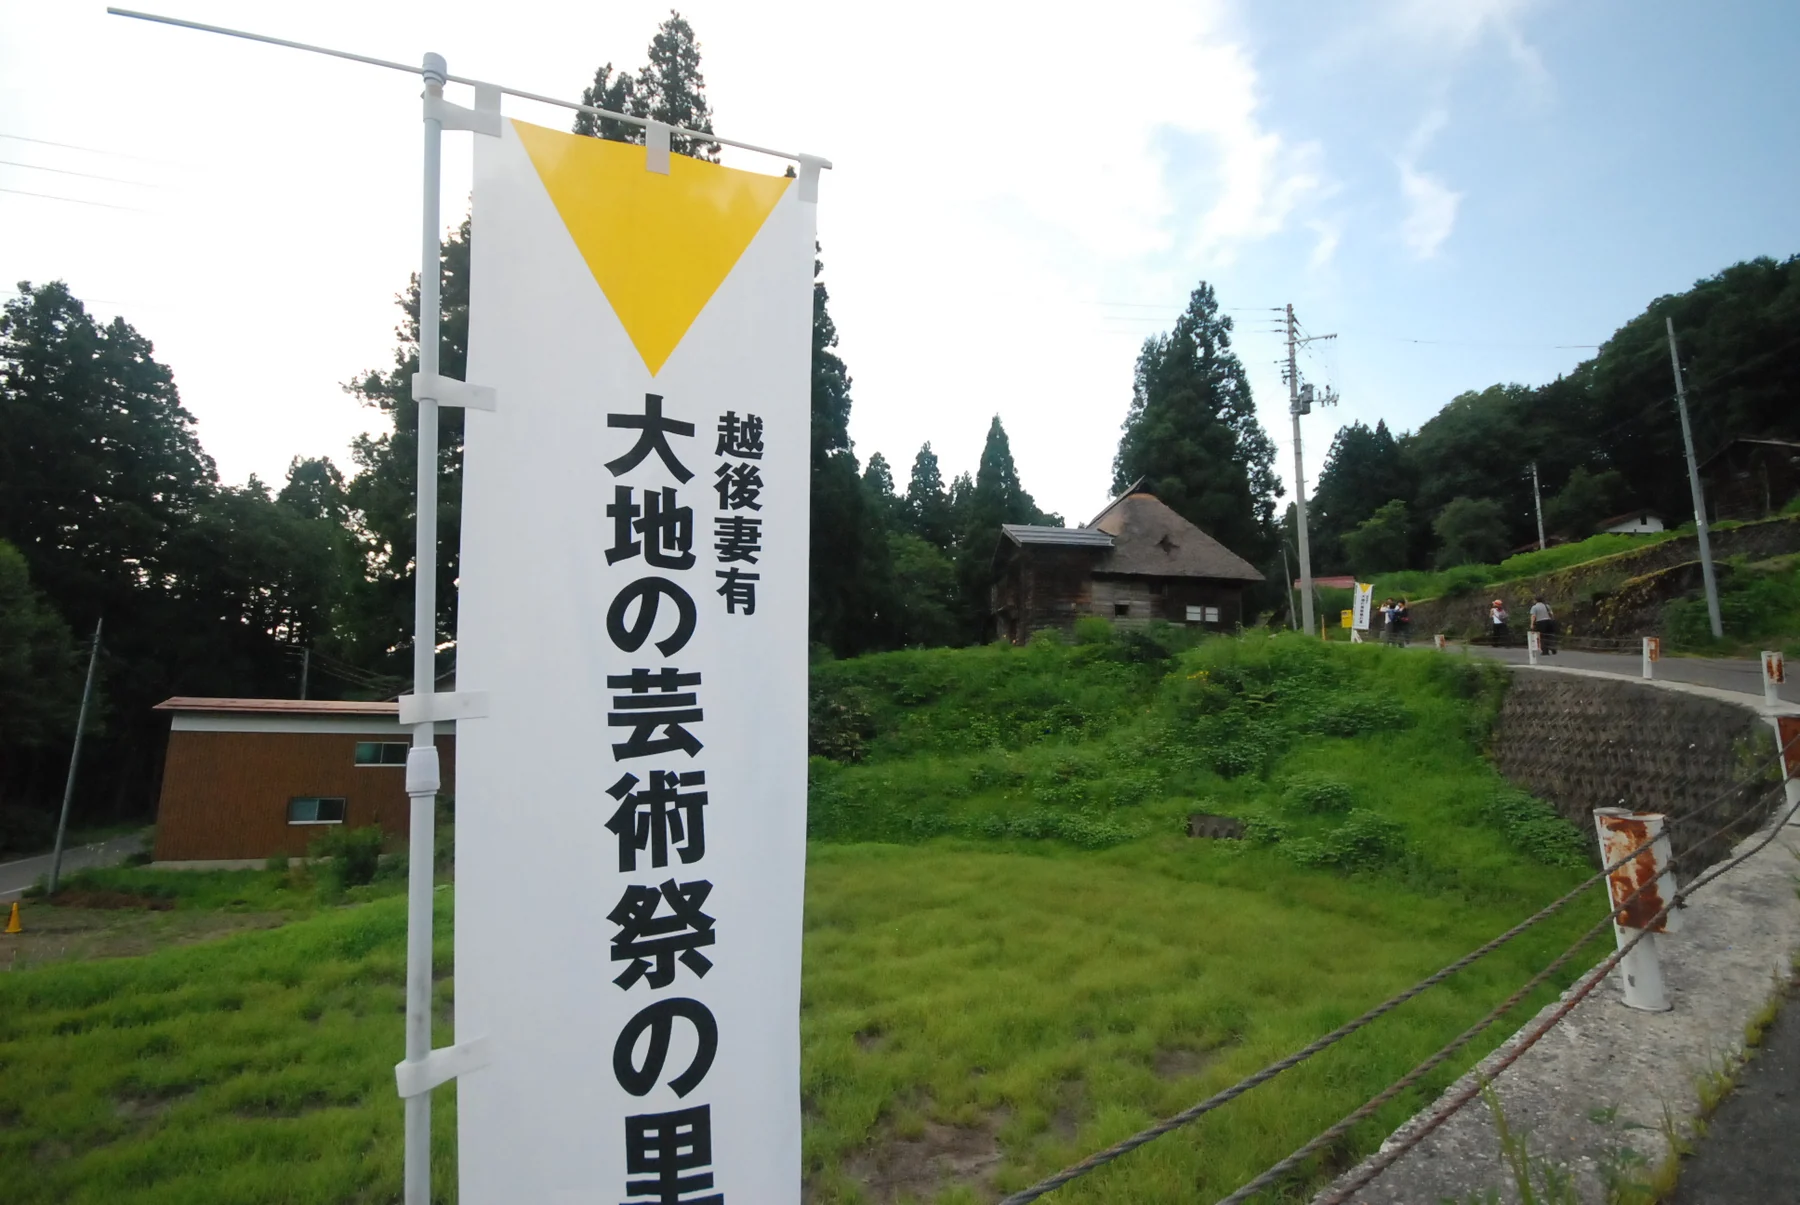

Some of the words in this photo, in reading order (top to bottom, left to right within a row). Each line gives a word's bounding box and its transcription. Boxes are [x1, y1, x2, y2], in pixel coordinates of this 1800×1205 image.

[714, 411, 764, 615] 越後妻有
[604, 394, 725, 1205] 大地の芸術祭の里
